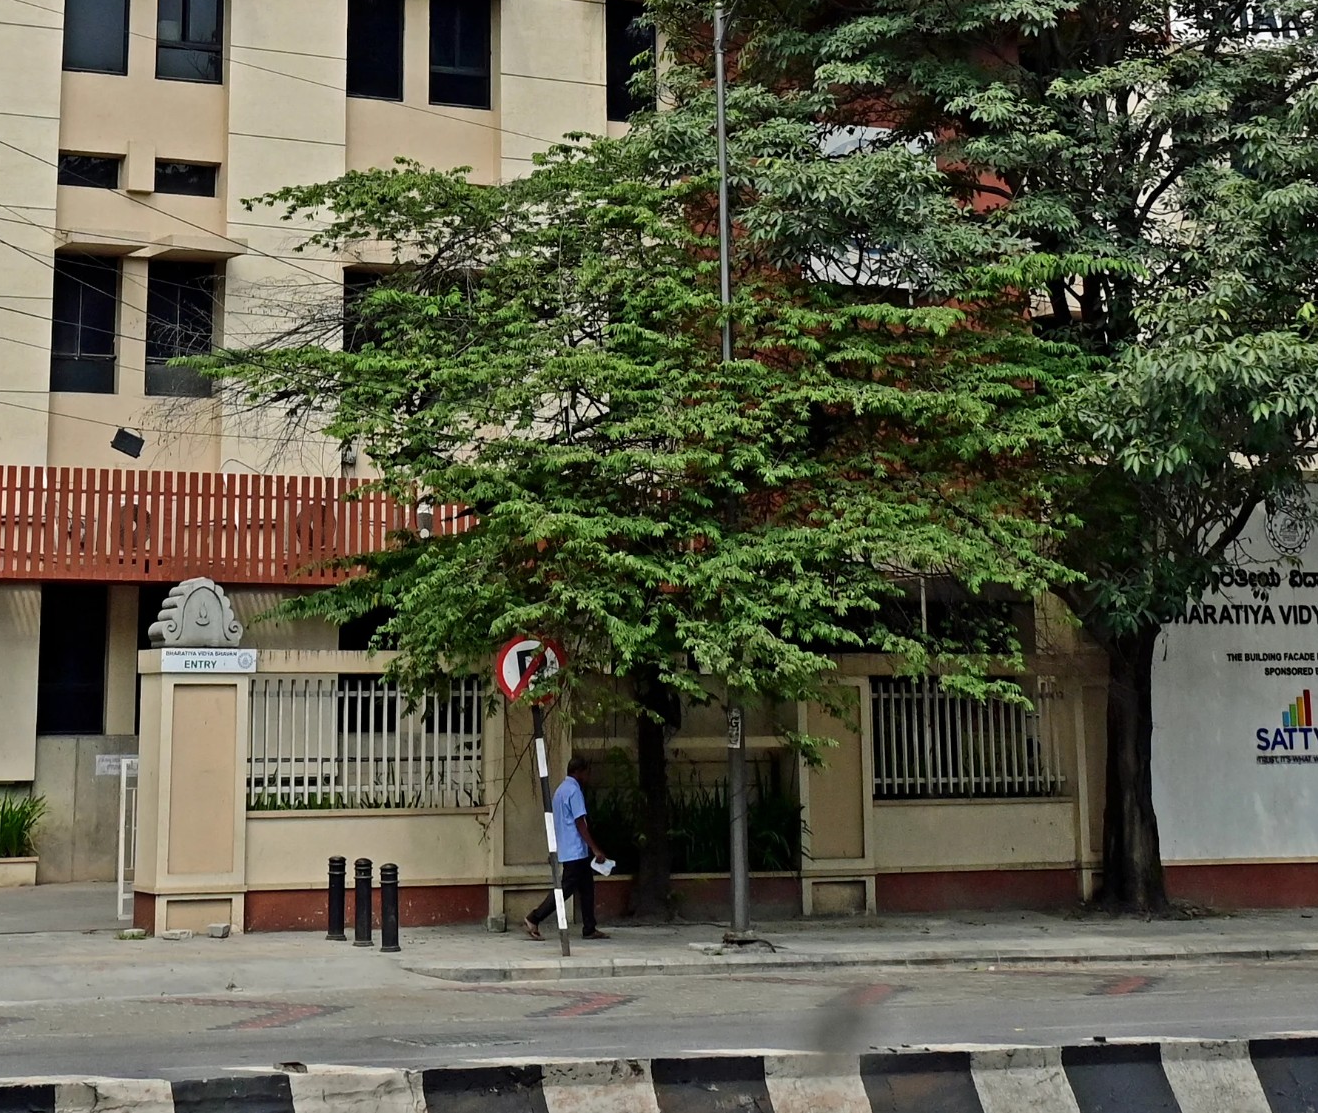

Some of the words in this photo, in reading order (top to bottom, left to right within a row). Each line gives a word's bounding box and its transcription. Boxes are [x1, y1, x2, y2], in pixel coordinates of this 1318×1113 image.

[1226, 653, 1243, 662] THE
[1244, 653, 1282, 662] BUILDING
[1283, 653, 1315, 661] FACADE
[184, 660, 217, 668] ENTRY
[1264, 667, 1313, 676] SPONSORED
